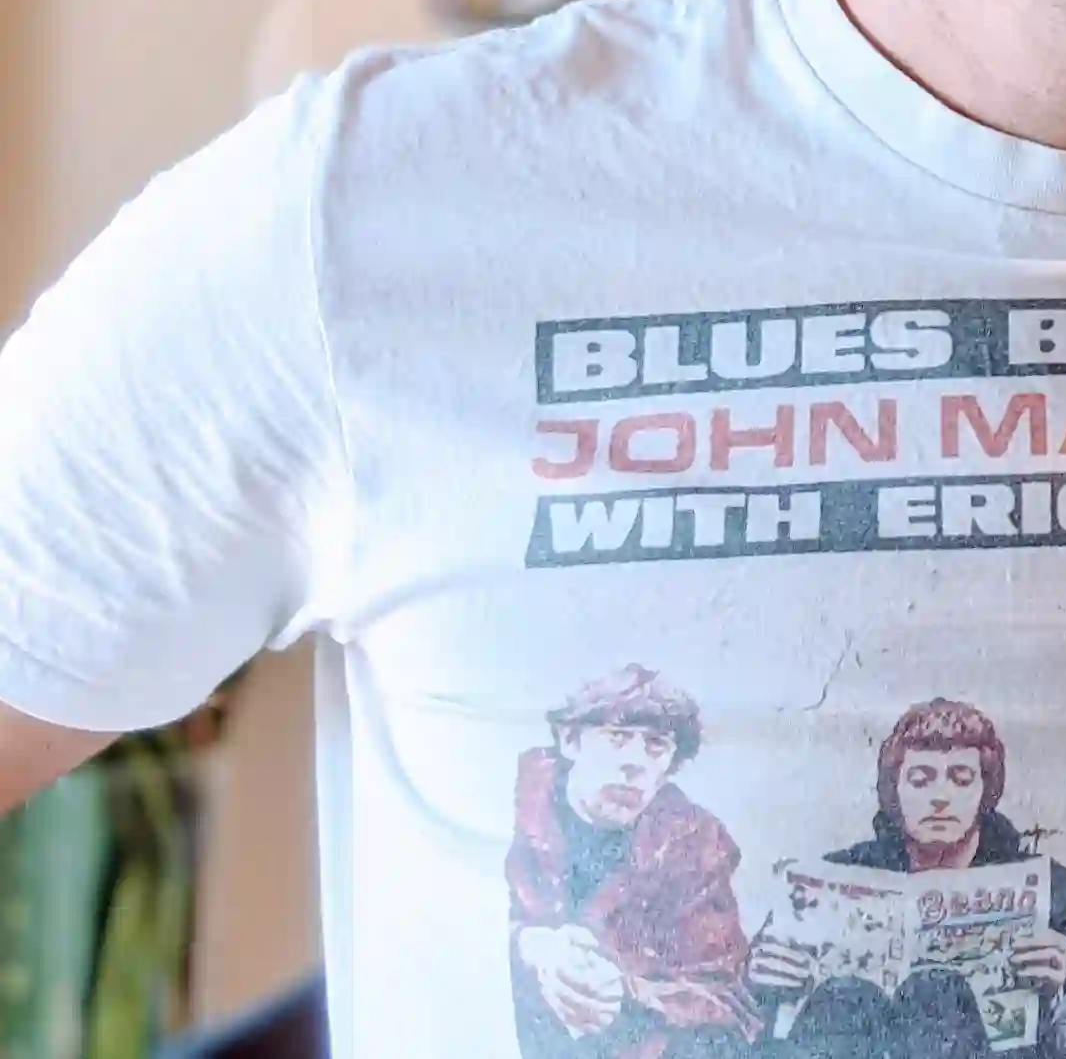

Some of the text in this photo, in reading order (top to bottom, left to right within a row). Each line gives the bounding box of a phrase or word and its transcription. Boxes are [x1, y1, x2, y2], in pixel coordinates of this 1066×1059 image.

[552, 309, 952, 393] BLUES
[531, 398, 897, 480] JOHN
[549, 490, 821, 554] WITH
